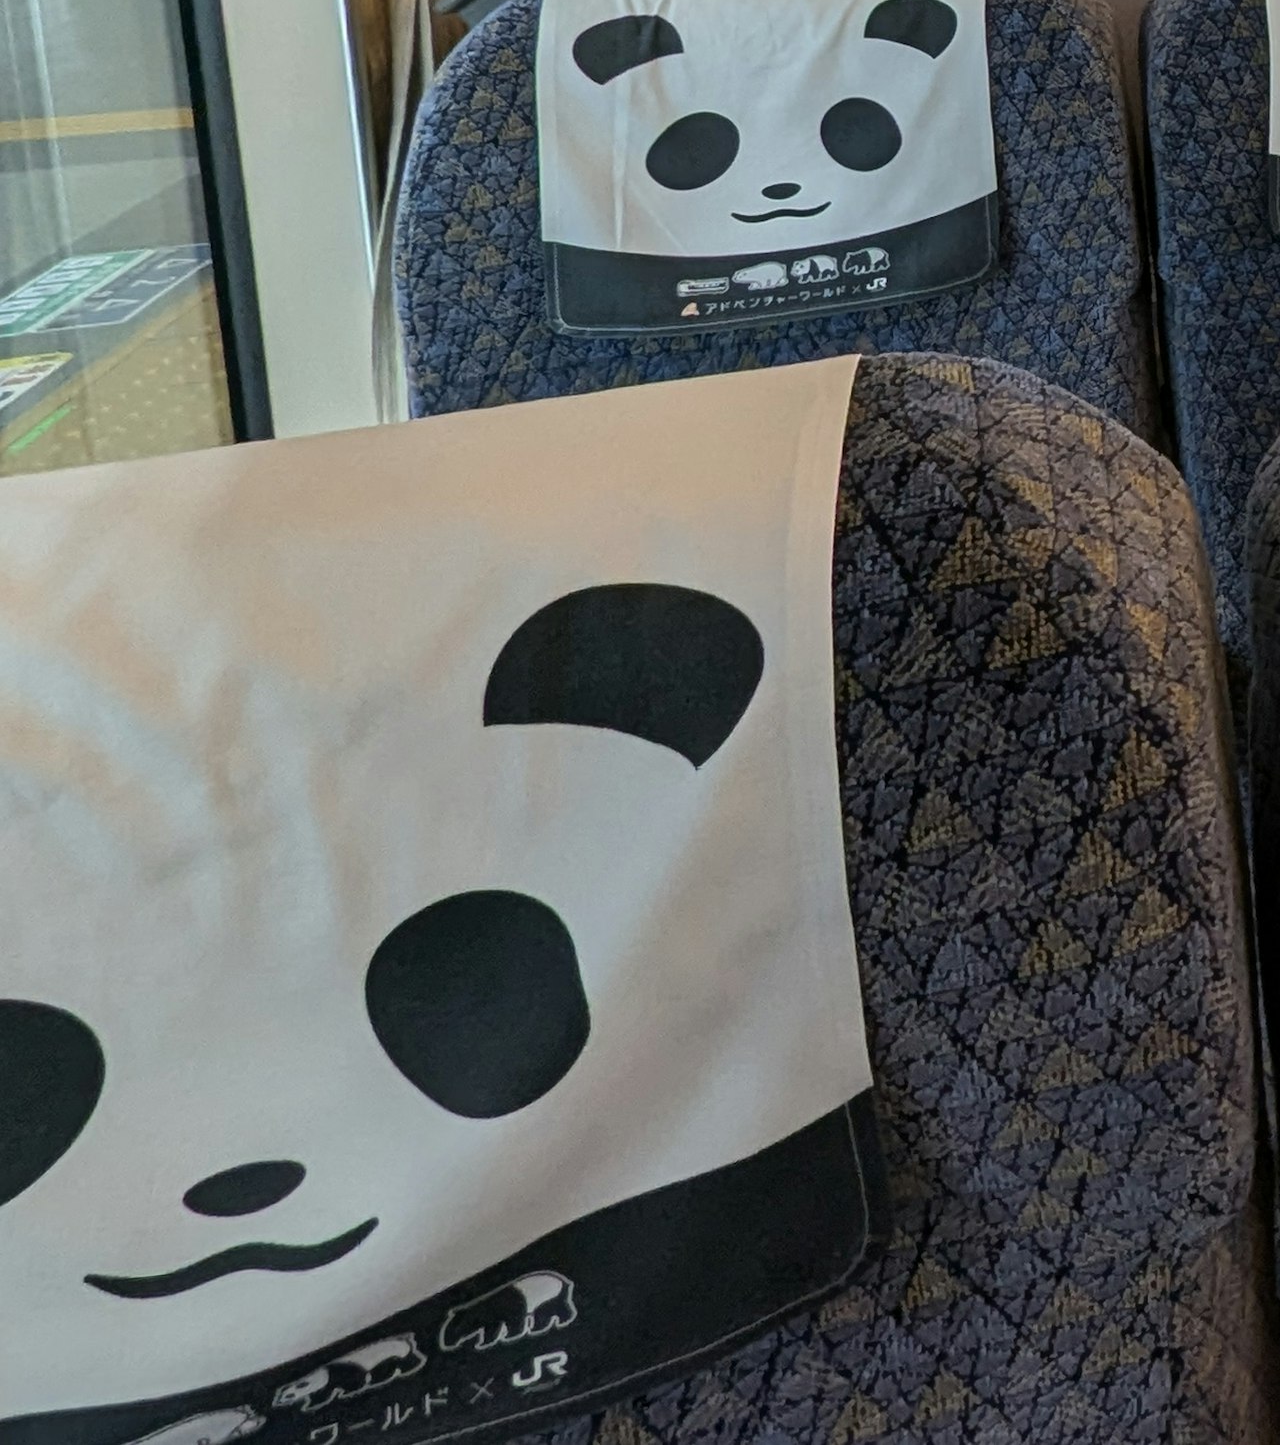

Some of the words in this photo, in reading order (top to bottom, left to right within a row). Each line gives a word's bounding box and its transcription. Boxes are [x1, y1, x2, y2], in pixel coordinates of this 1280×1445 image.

[704, 285, 846, 316] アドベンチャーワールド
[865, 276, 888, 291] JR
[512, 1350, 569, 1387] JR
